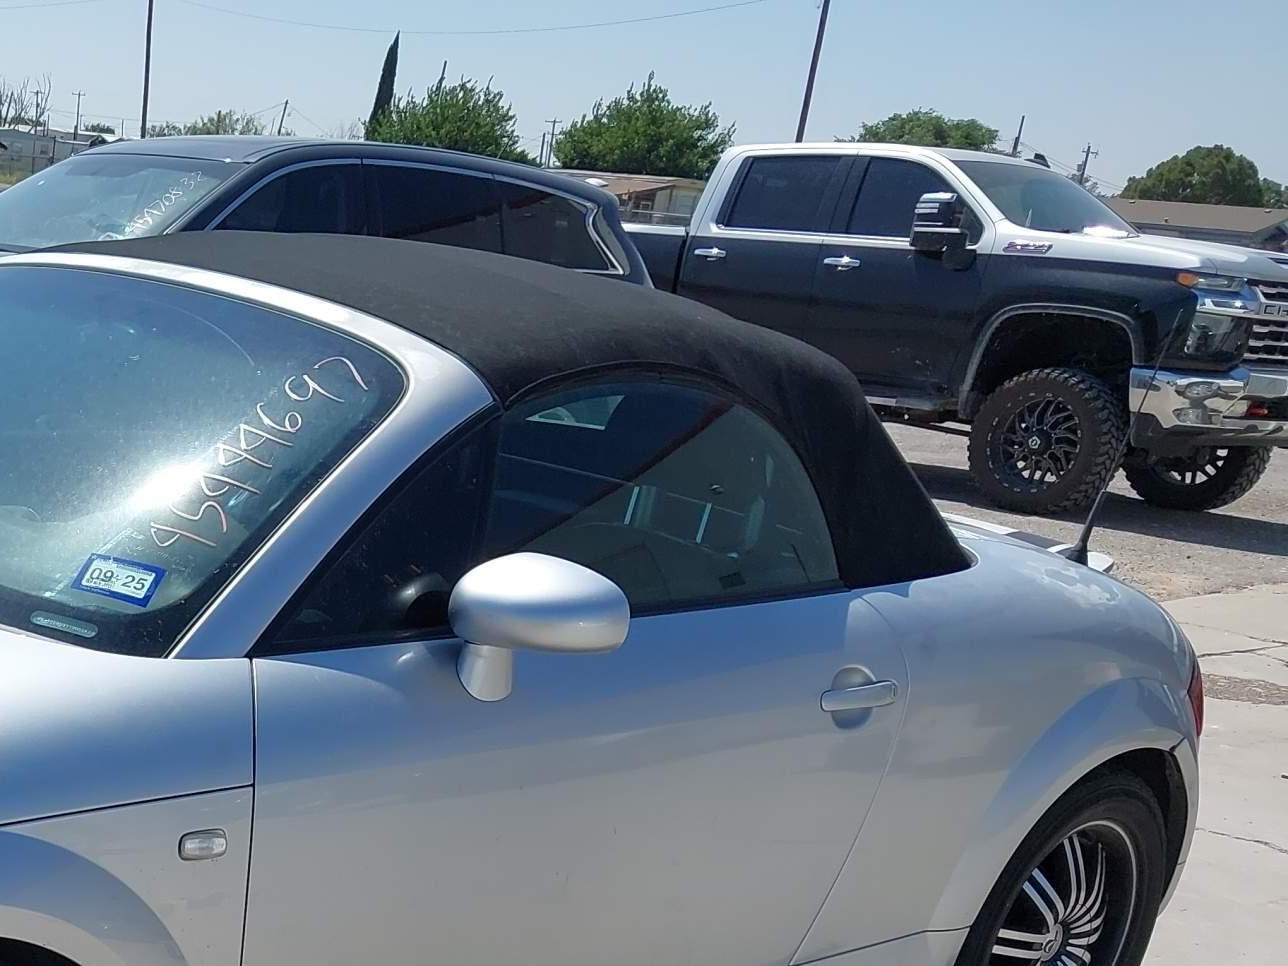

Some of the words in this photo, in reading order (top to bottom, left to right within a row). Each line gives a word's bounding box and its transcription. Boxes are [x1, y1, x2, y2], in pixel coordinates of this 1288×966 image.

[150, 356, 368, 547] 45444697
[89, 567, 114, 583] 09
[121, 574, 148, 591] 25
